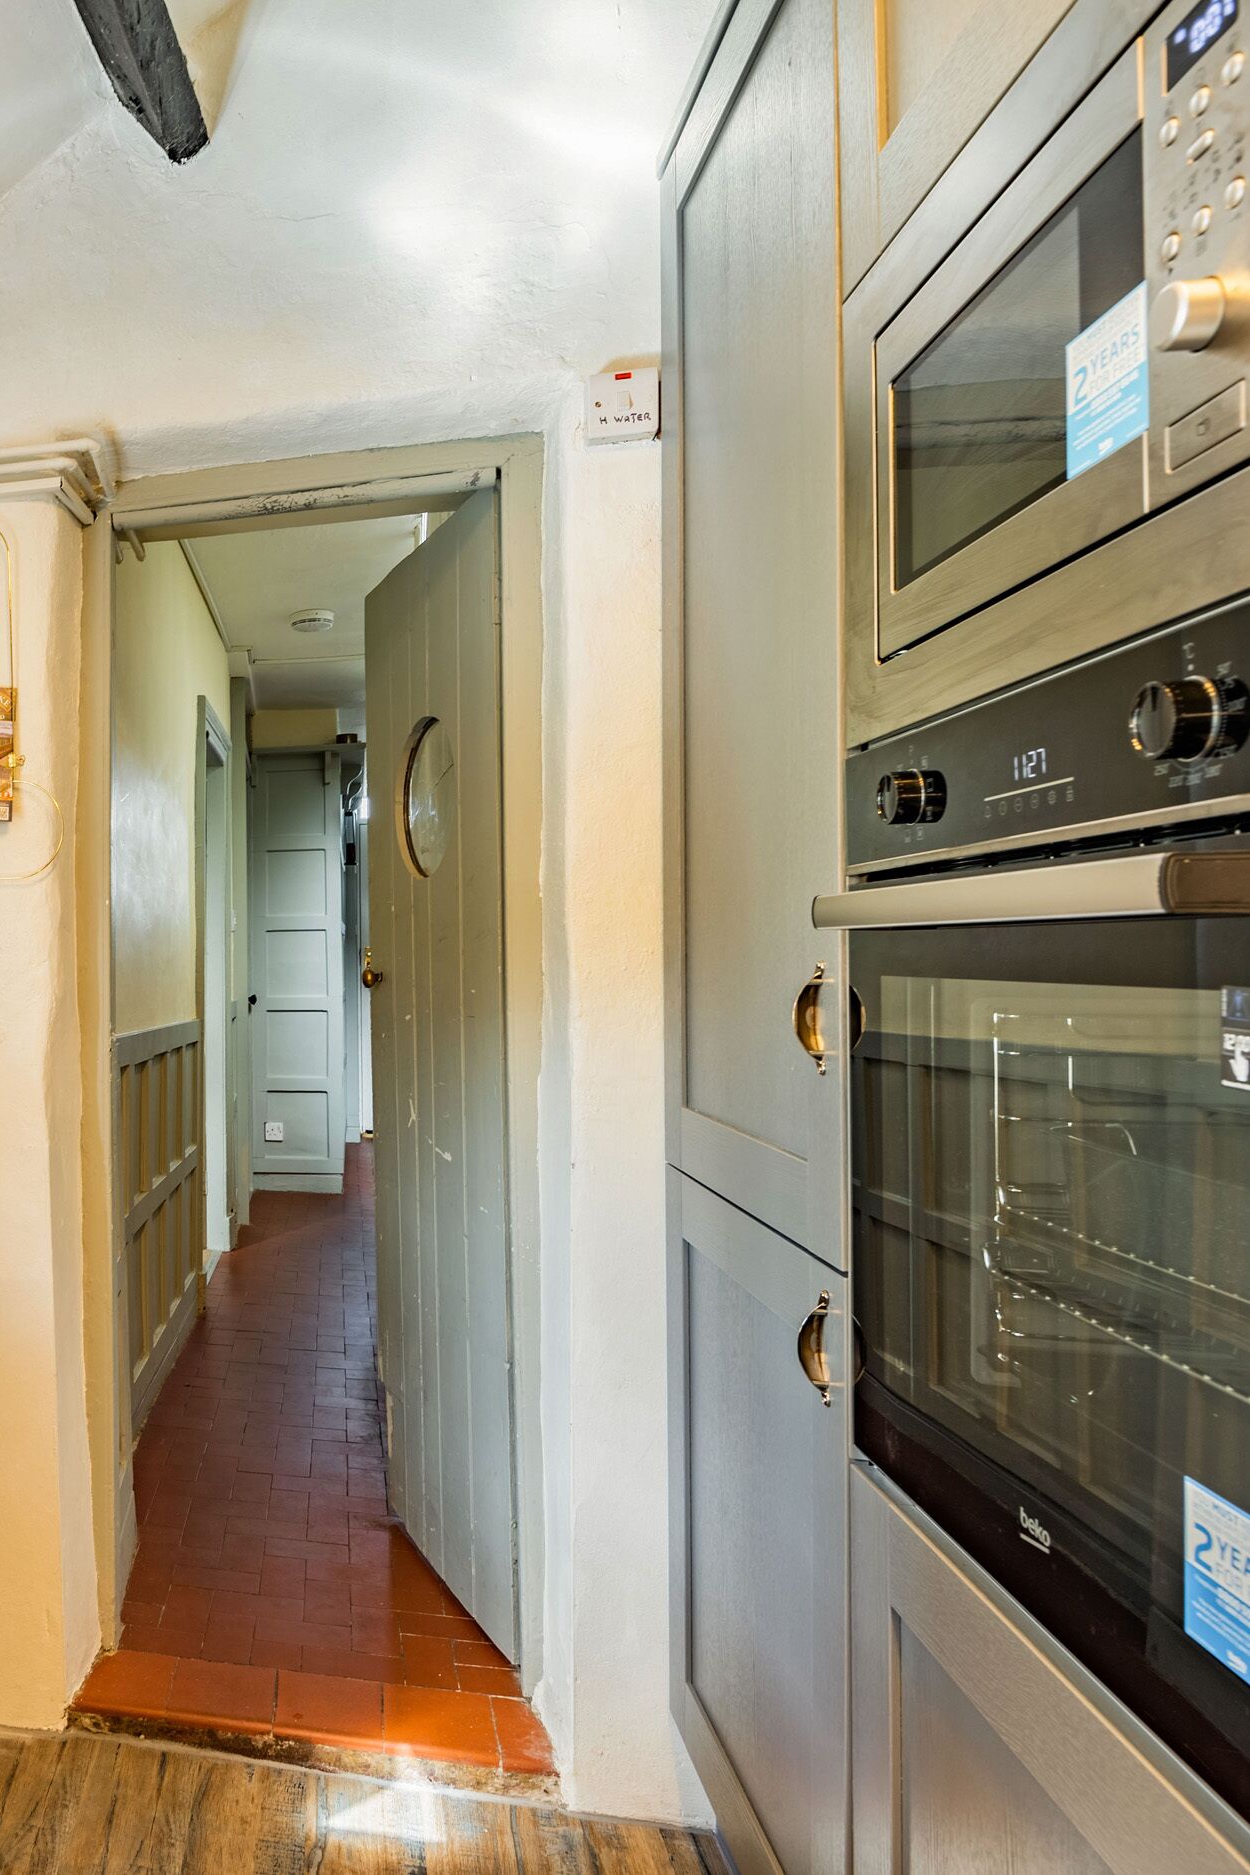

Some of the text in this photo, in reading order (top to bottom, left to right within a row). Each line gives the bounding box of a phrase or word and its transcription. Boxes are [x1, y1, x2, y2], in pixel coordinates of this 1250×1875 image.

[1074, 366, 1087, 405] 2
[1090, 323, 1140, 374] YEARS
[614, 412, 651, 423] WATER
[1020, 1506, 1050, 1547] beko
[1194, 1521, 1212, 1572] 2
